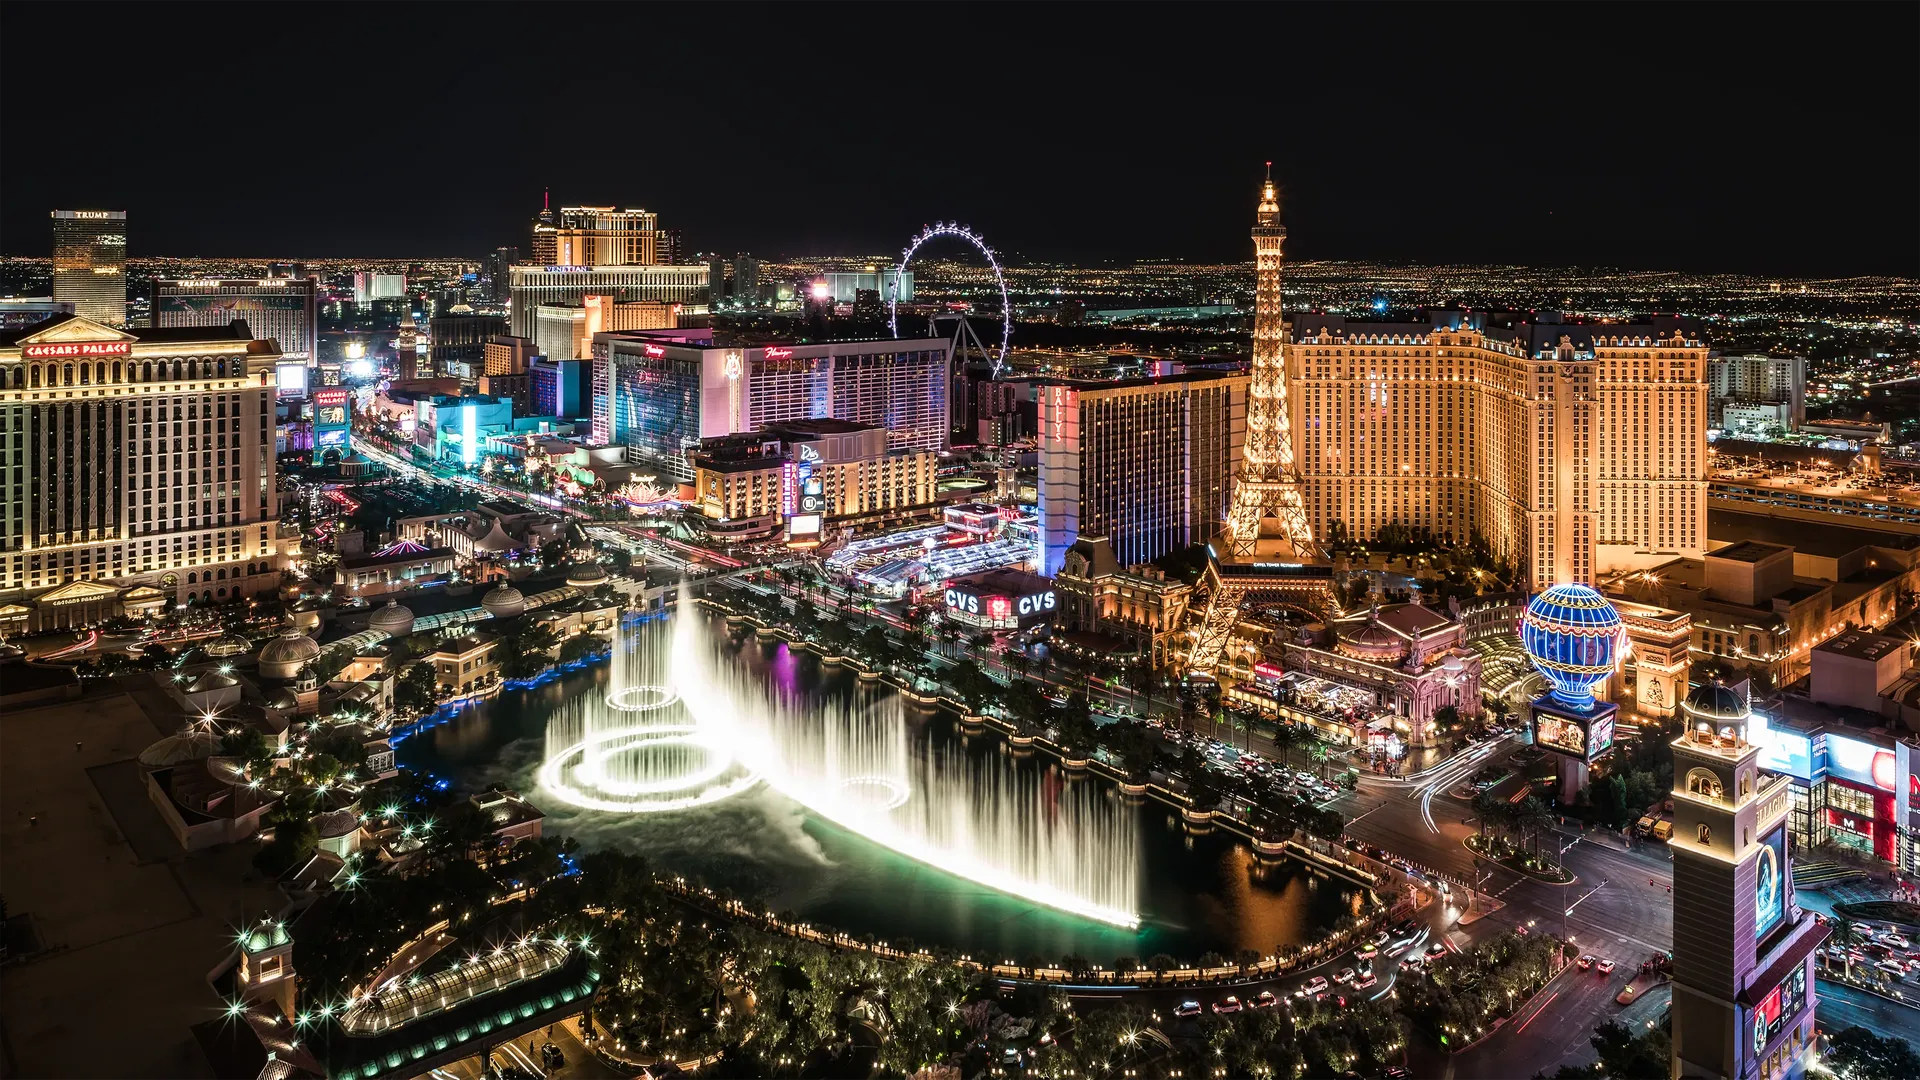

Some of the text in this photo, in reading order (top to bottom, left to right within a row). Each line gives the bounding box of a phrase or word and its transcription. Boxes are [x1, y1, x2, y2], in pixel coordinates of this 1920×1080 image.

[75, 211, 109, 219] TRUMP
[534, 223, 558, 232] Encore
[26, 343, 128, 357] CAESARS PALACE
[765, 346, 793, 359] Flamingo
[279, 352, 309, 360] MIRAGE
[317, 391, 347, 399] CAESARS
[319, 397, 345, 405] PALACE
[945, 589, 979, 613] CVS
[1019, 591, 1055, 614] CVS
[1843, 817, 1855, 829] M
